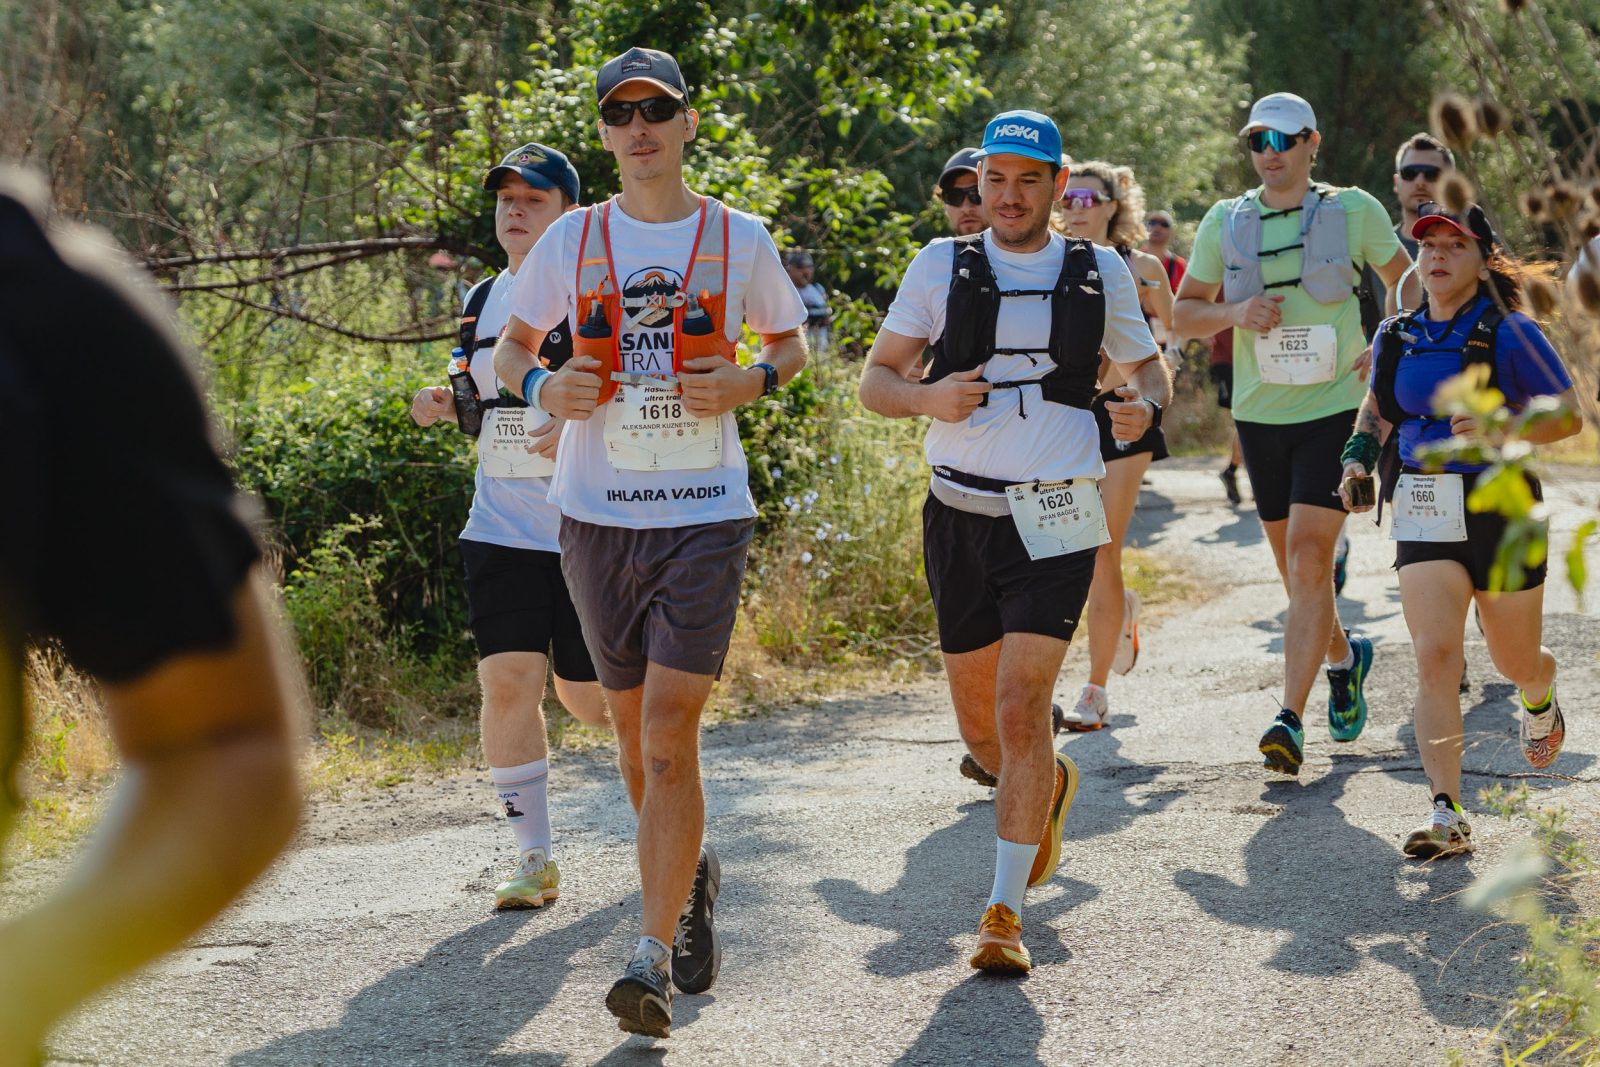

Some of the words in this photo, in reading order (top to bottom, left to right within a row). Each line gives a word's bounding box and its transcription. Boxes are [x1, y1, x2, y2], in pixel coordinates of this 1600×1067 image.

[993, 124, 1039, 143] HOKA
[1279, 339, 1309, 351] 1623
[666, 393, 682, 401] trail
[639, 403, 682, 420] 1618
[495, 423, 525, 436] 1703
[607, 489, 667, 502] IHLARA
[671, 485, 726, 500] VADISI
[1039, 487, 1055, 495] ultra
[1410, 490, 1435, 502] 1660
[1038, 491, 1074, 511] 1620
